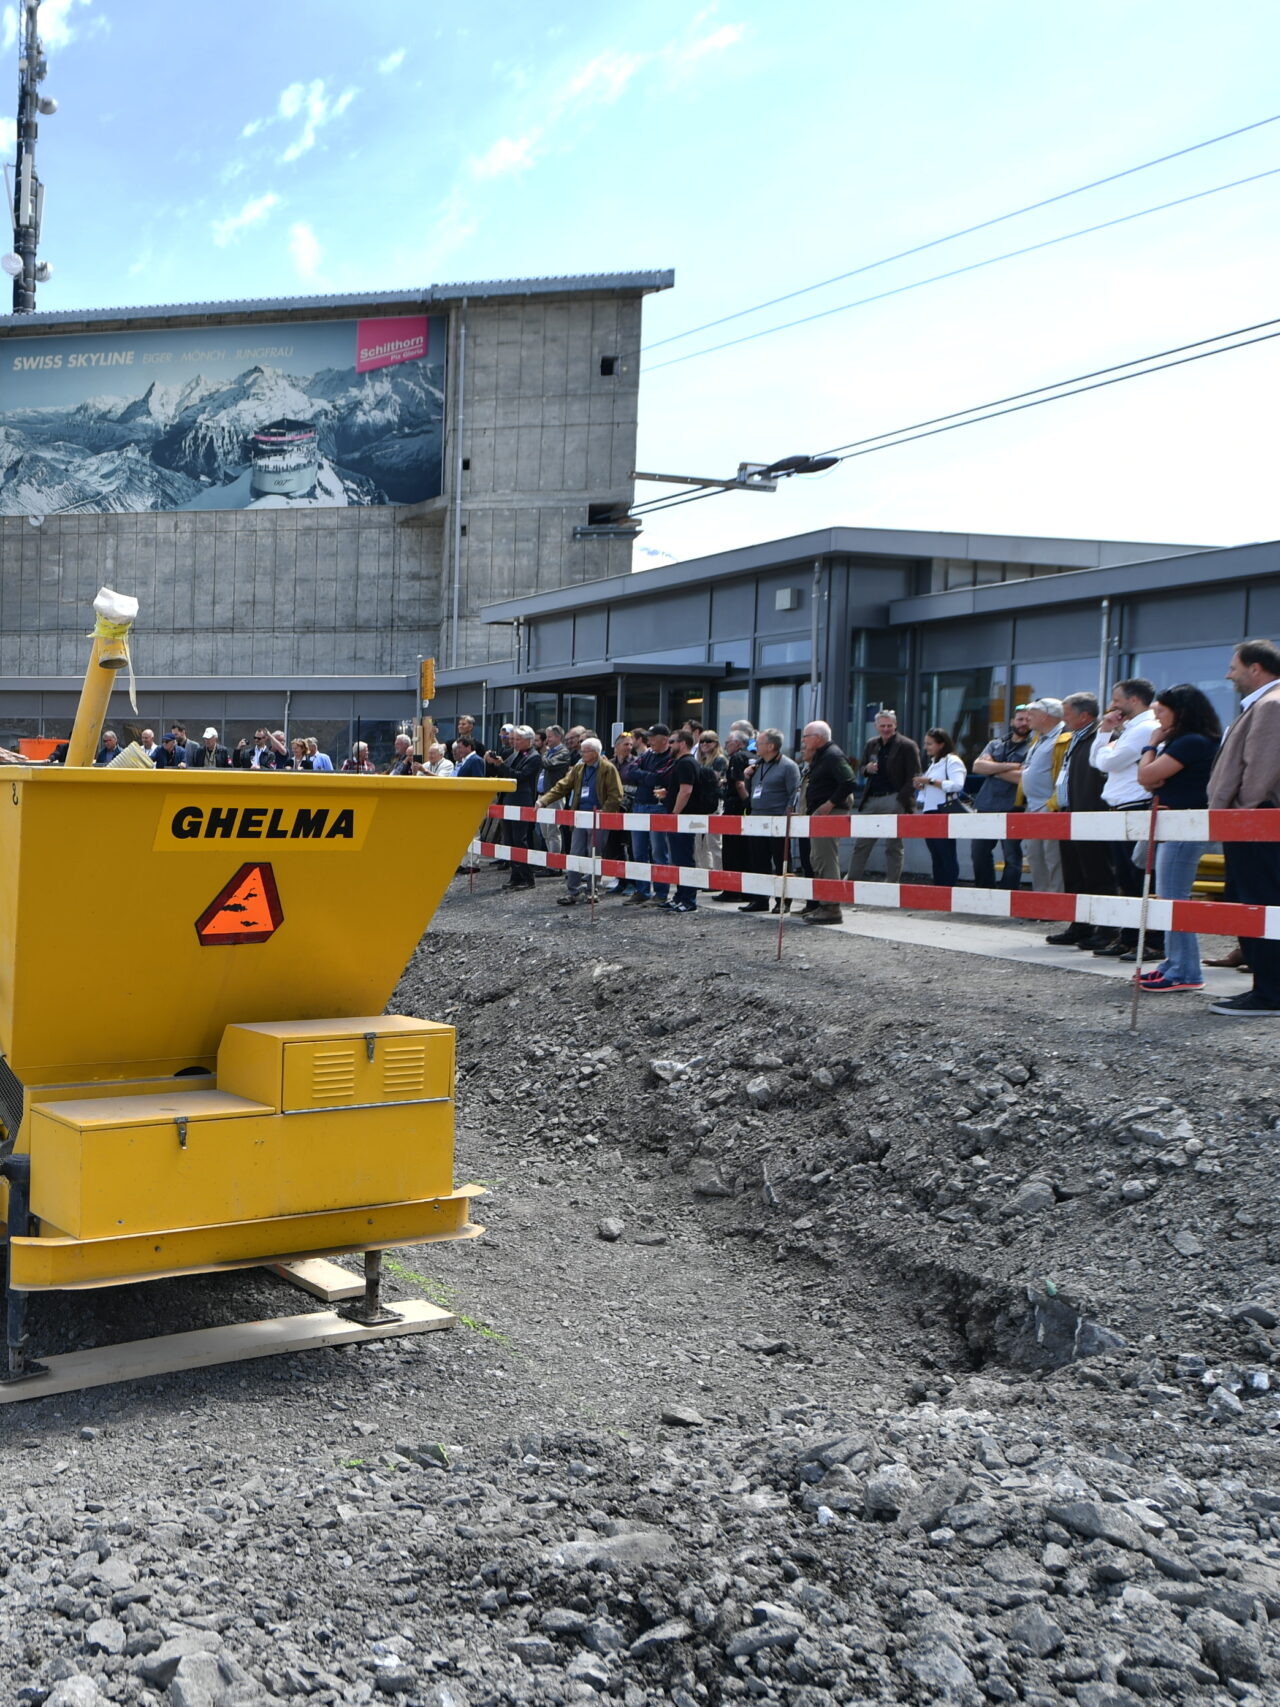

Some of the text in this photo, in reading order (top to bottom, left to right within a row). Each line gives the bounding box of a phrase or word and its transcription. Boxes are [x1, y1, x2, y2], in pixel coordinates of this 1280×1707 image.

[13, 355, 63, 371] SWISS
[67, 350, 135, 368] SKYLINE
[234, 346, 294, 360] JUNGFRAU
[360, 335, 424, 359] Schilthorn
[171, 806, 355, 839] GHELMA
